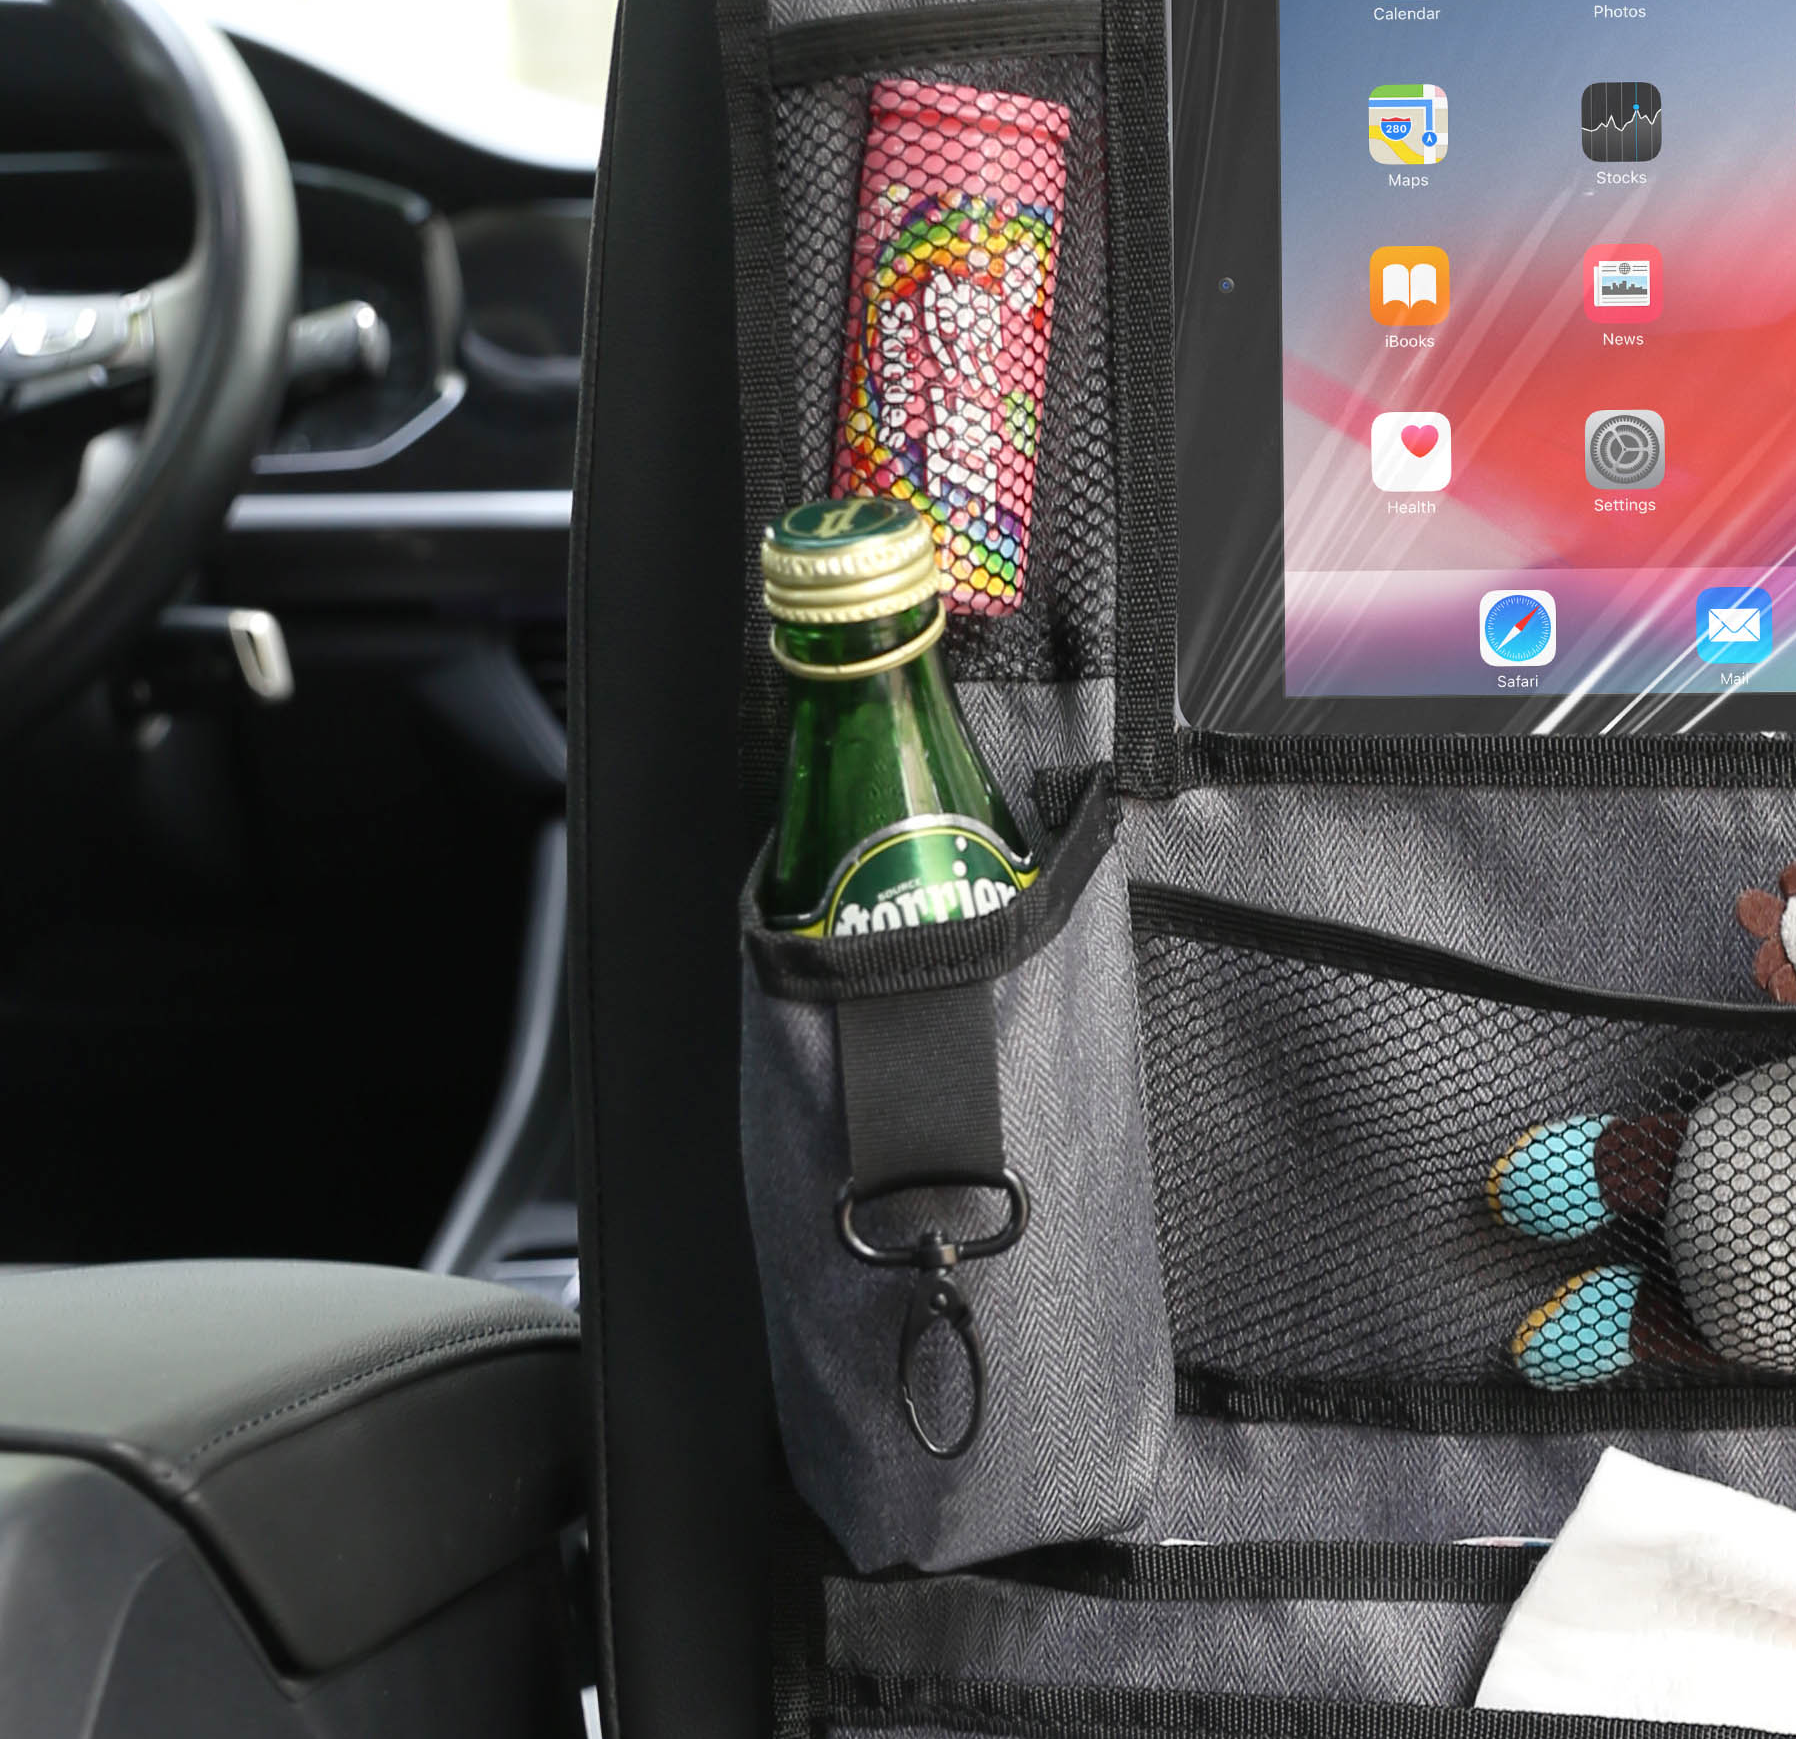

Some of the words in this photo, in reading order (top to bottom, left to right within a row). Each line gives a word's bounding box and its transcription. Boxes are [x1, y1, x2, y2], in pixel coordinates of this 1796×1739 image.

[1373, 6, 1440, 20] Calendar
[1594, 5, 1647, 19] Photos
[1385, 124, 1407, 135] 280
[1388, 174, 1429, 190] Maps
[1596, 170, 1647, 185] Stocks
[1385, 334, 1435, 348] iBooks
[1603, 333, 1644, 346] News
[1387, 501, 1436, 514] Health
[1594, 498, 1656, 515] Settings
[1497, 675, 1539, 688] Safari
[1720, 672, 1749, 685] Mail
